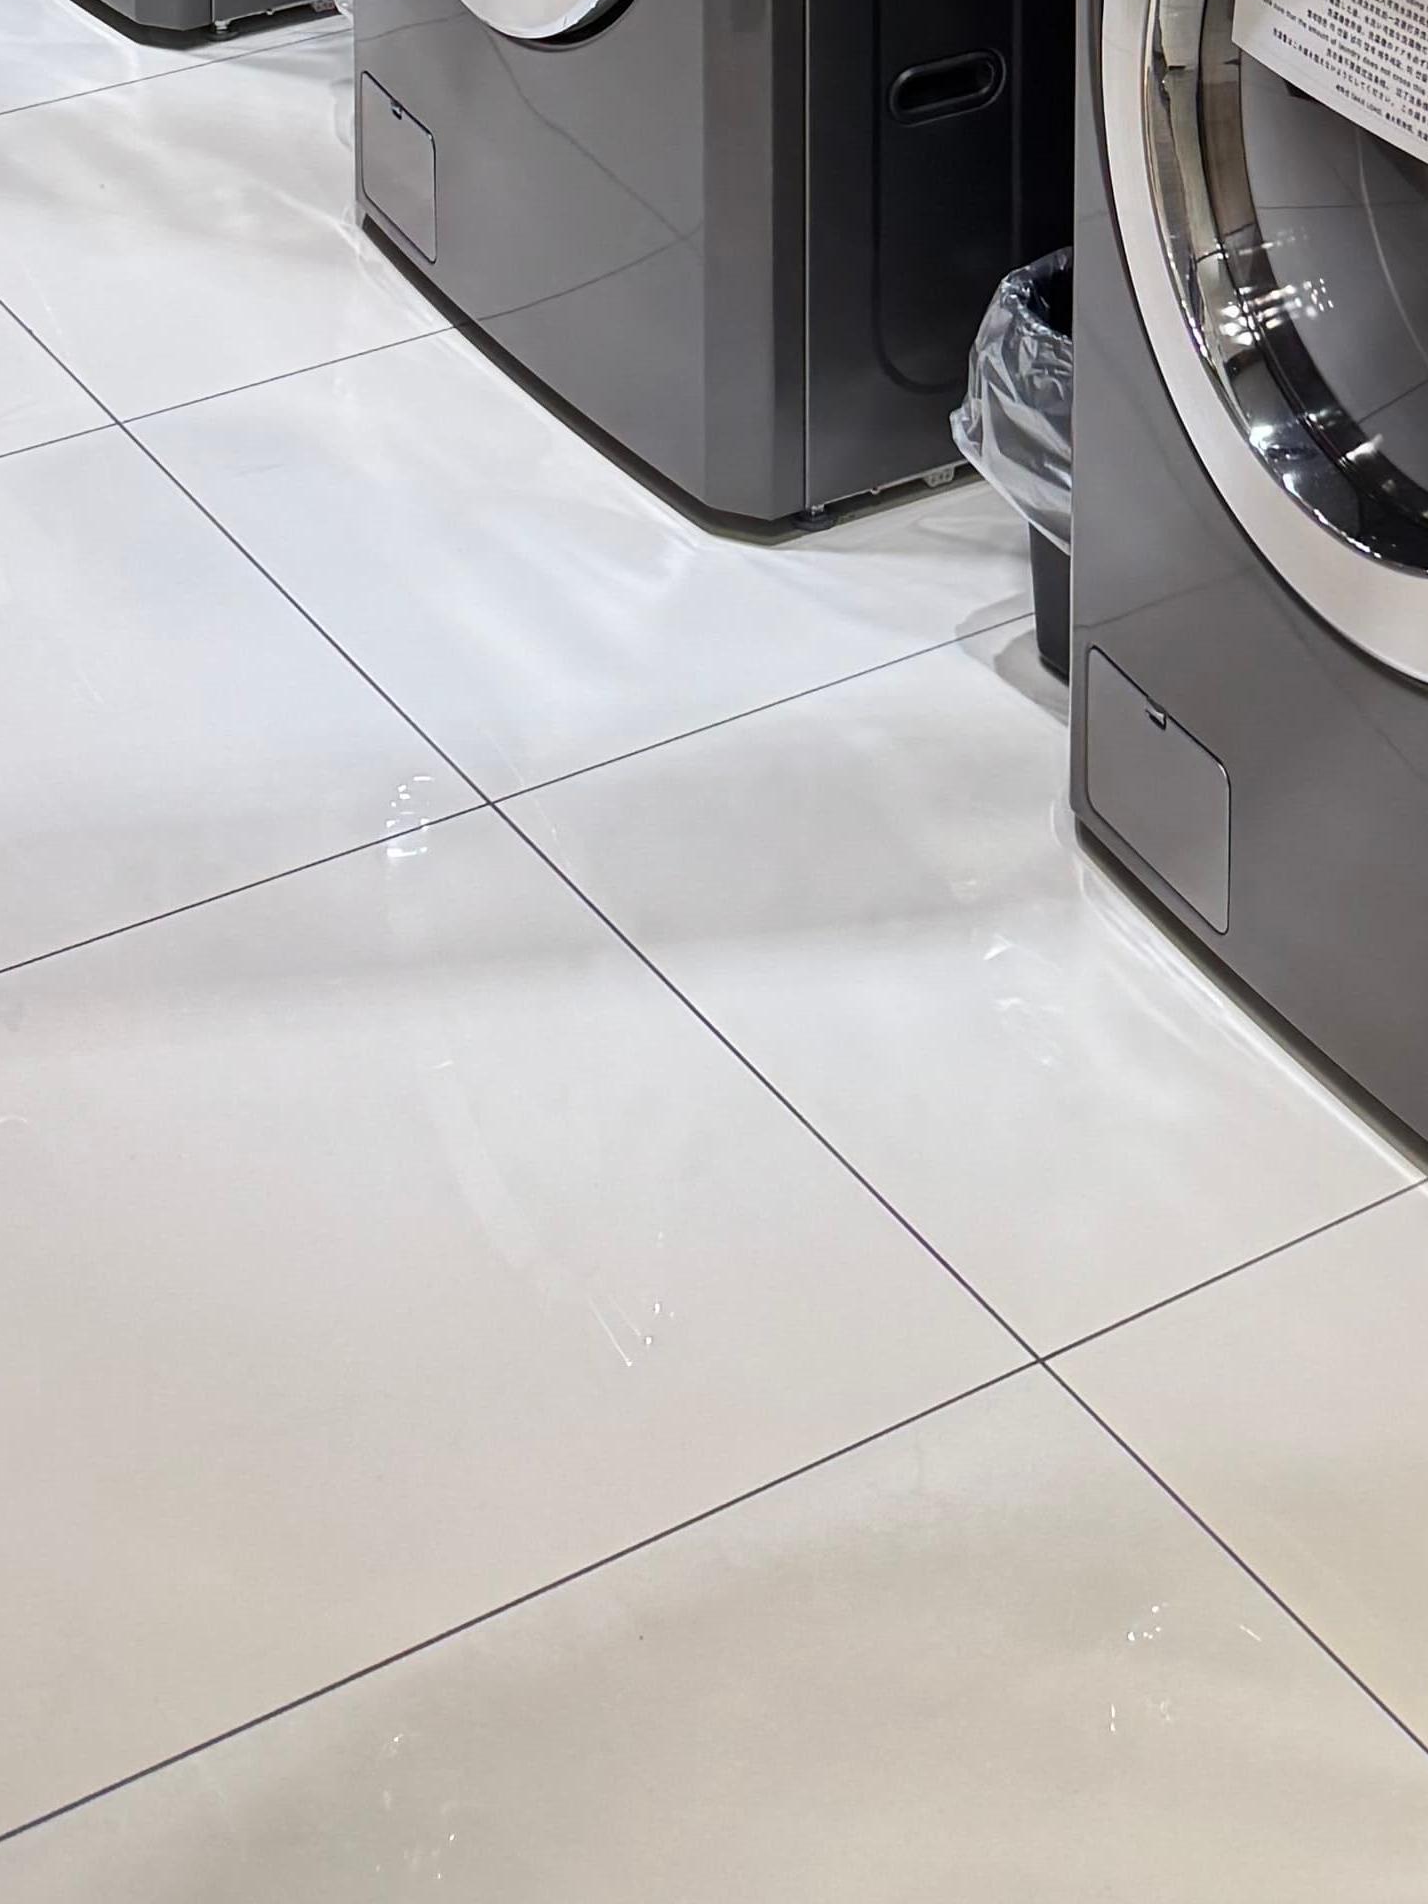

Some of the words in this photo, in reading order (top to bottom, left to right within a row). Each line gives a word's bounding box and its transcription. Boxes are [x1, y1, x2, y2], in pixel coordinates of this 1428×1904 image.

[1273, 0, 1284, 14] sure
[1285, 9, 1296, 22] that
[1297, 15, 1307, 29] the
[1307, 22, 1329, 42] amount
[1330, 36, 1337, 46] of
[1338, 41, 1361, 61] laundry
[1362, 55, 1378, 70] does
[1380, 64, 1391, 77] not
[1392, 70, 1411, 89] cross
[1413, 82, 1425, 96] this
